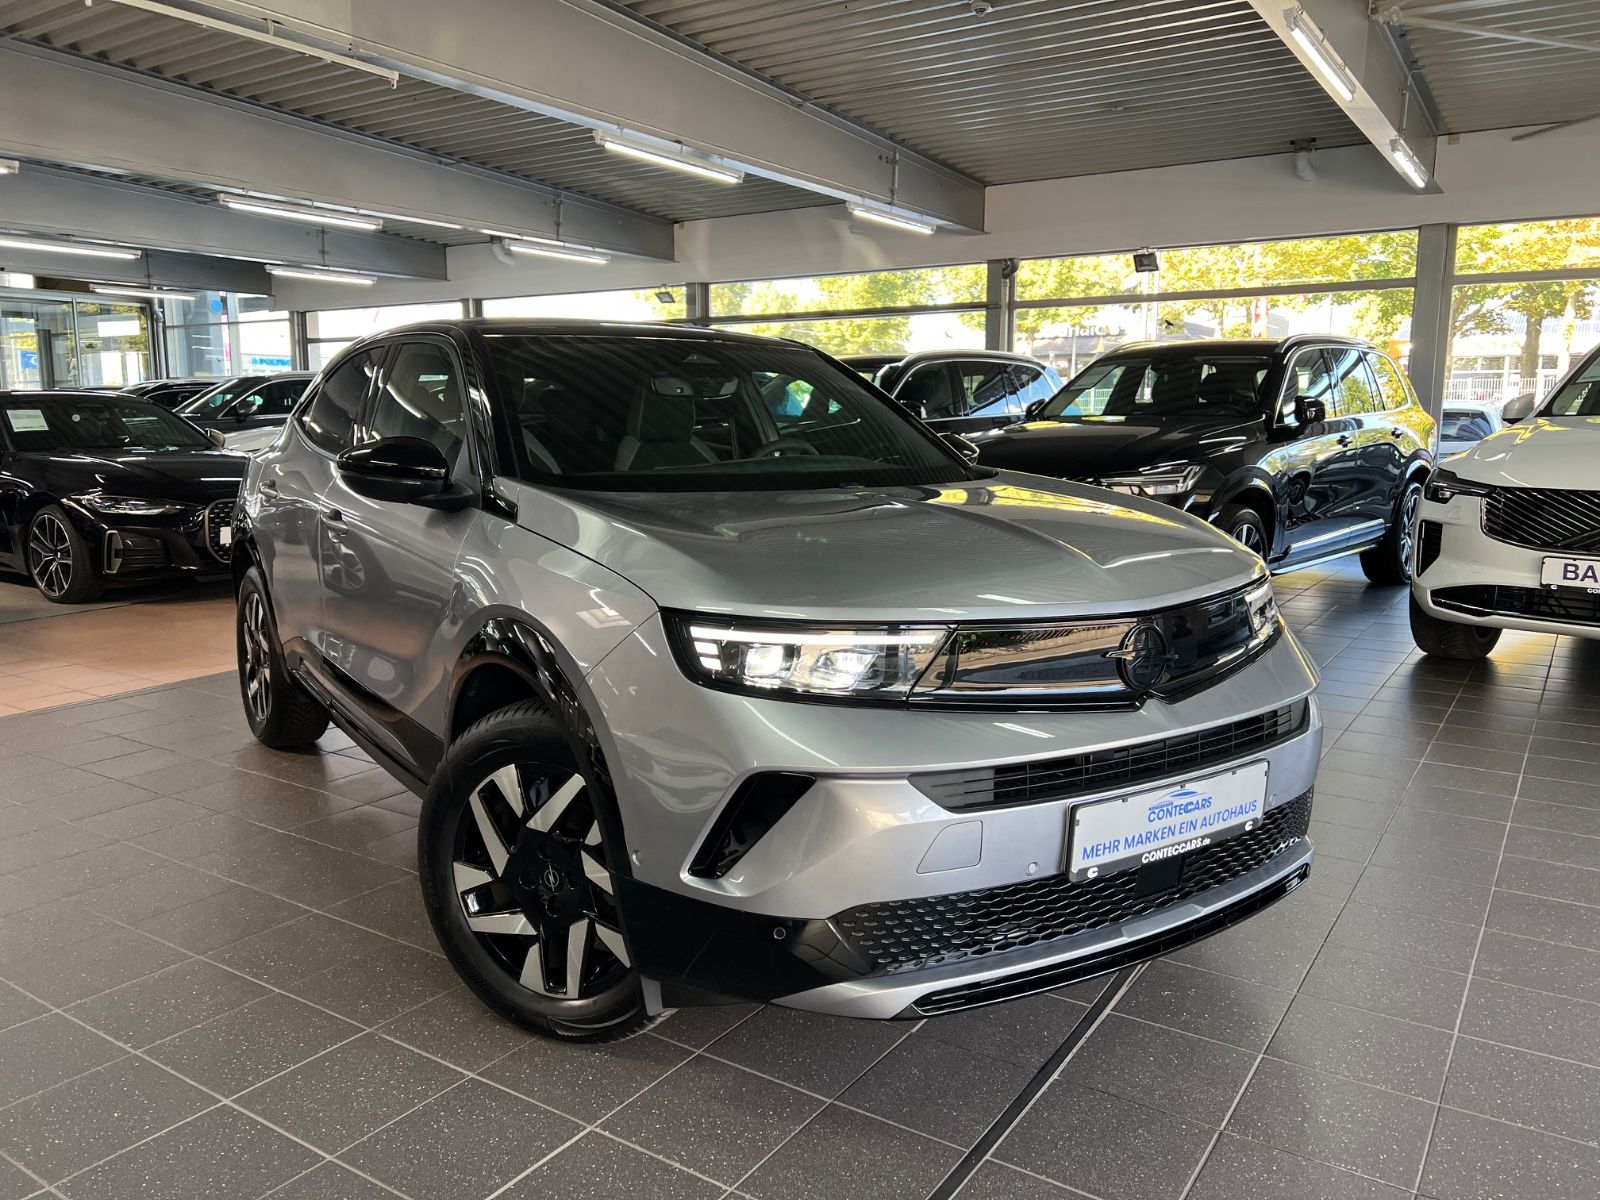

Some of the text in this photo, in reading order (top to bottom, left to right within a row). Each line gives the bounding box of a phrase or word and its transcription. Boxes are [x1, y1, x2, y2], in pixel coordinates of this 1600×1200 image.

[1082, 840, 1120, 861] MEHR
[1124, 825, 1176, 850] MARKEN
[1178, 819, 1197, 835] EIN
[1200, 800, 1257, 827] AUTOHAUS
[1142, 837, 1211, 863] CONTECCARS.de
